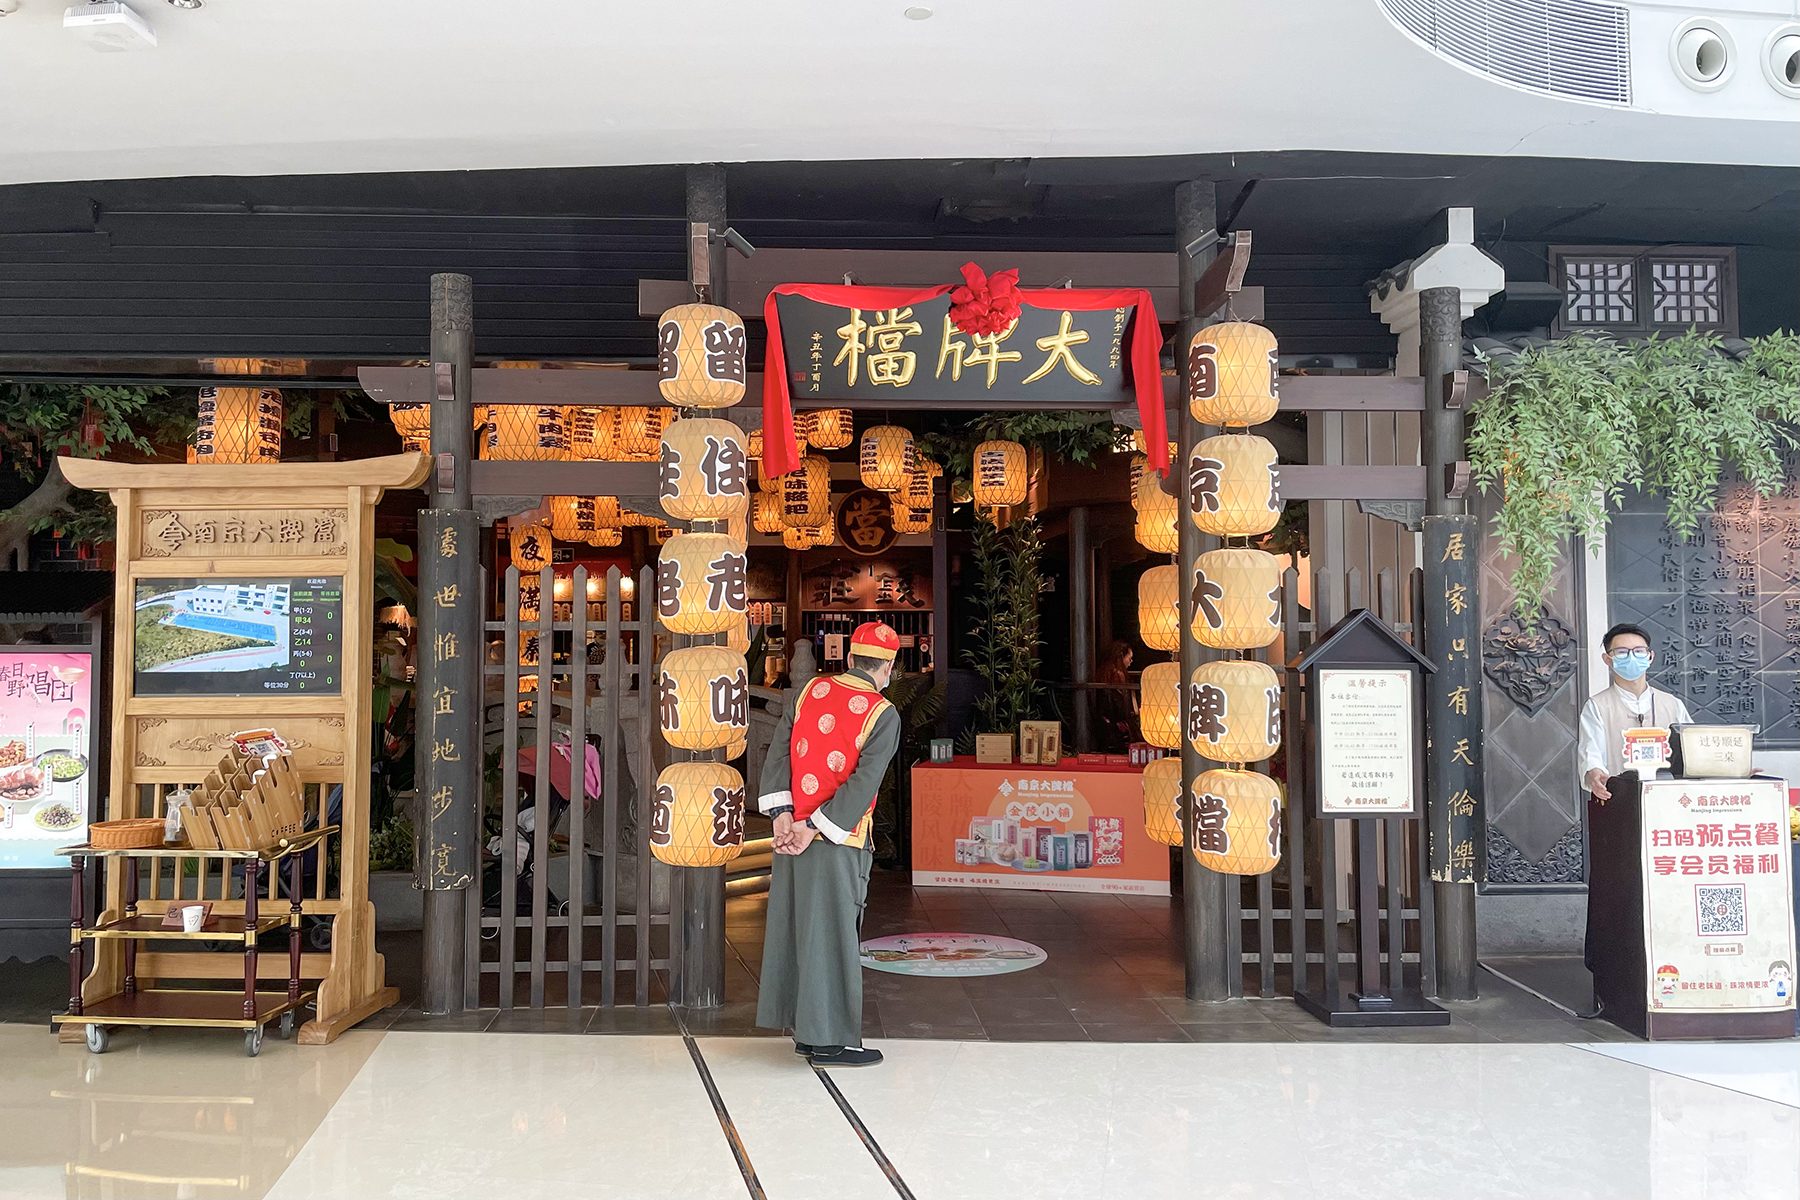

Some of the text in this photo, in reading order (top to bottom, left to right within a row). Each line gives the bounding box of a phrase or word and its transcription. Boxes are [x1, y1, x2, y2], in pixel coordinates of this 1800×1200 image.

[294, 616, 311, 624] 甲34
[1699, 735, 1743, 748] 过号顺延
[1652, 822, 1779, 848] 扫码预点餐
[1653, 853, 1779, 876] 享会员福利
